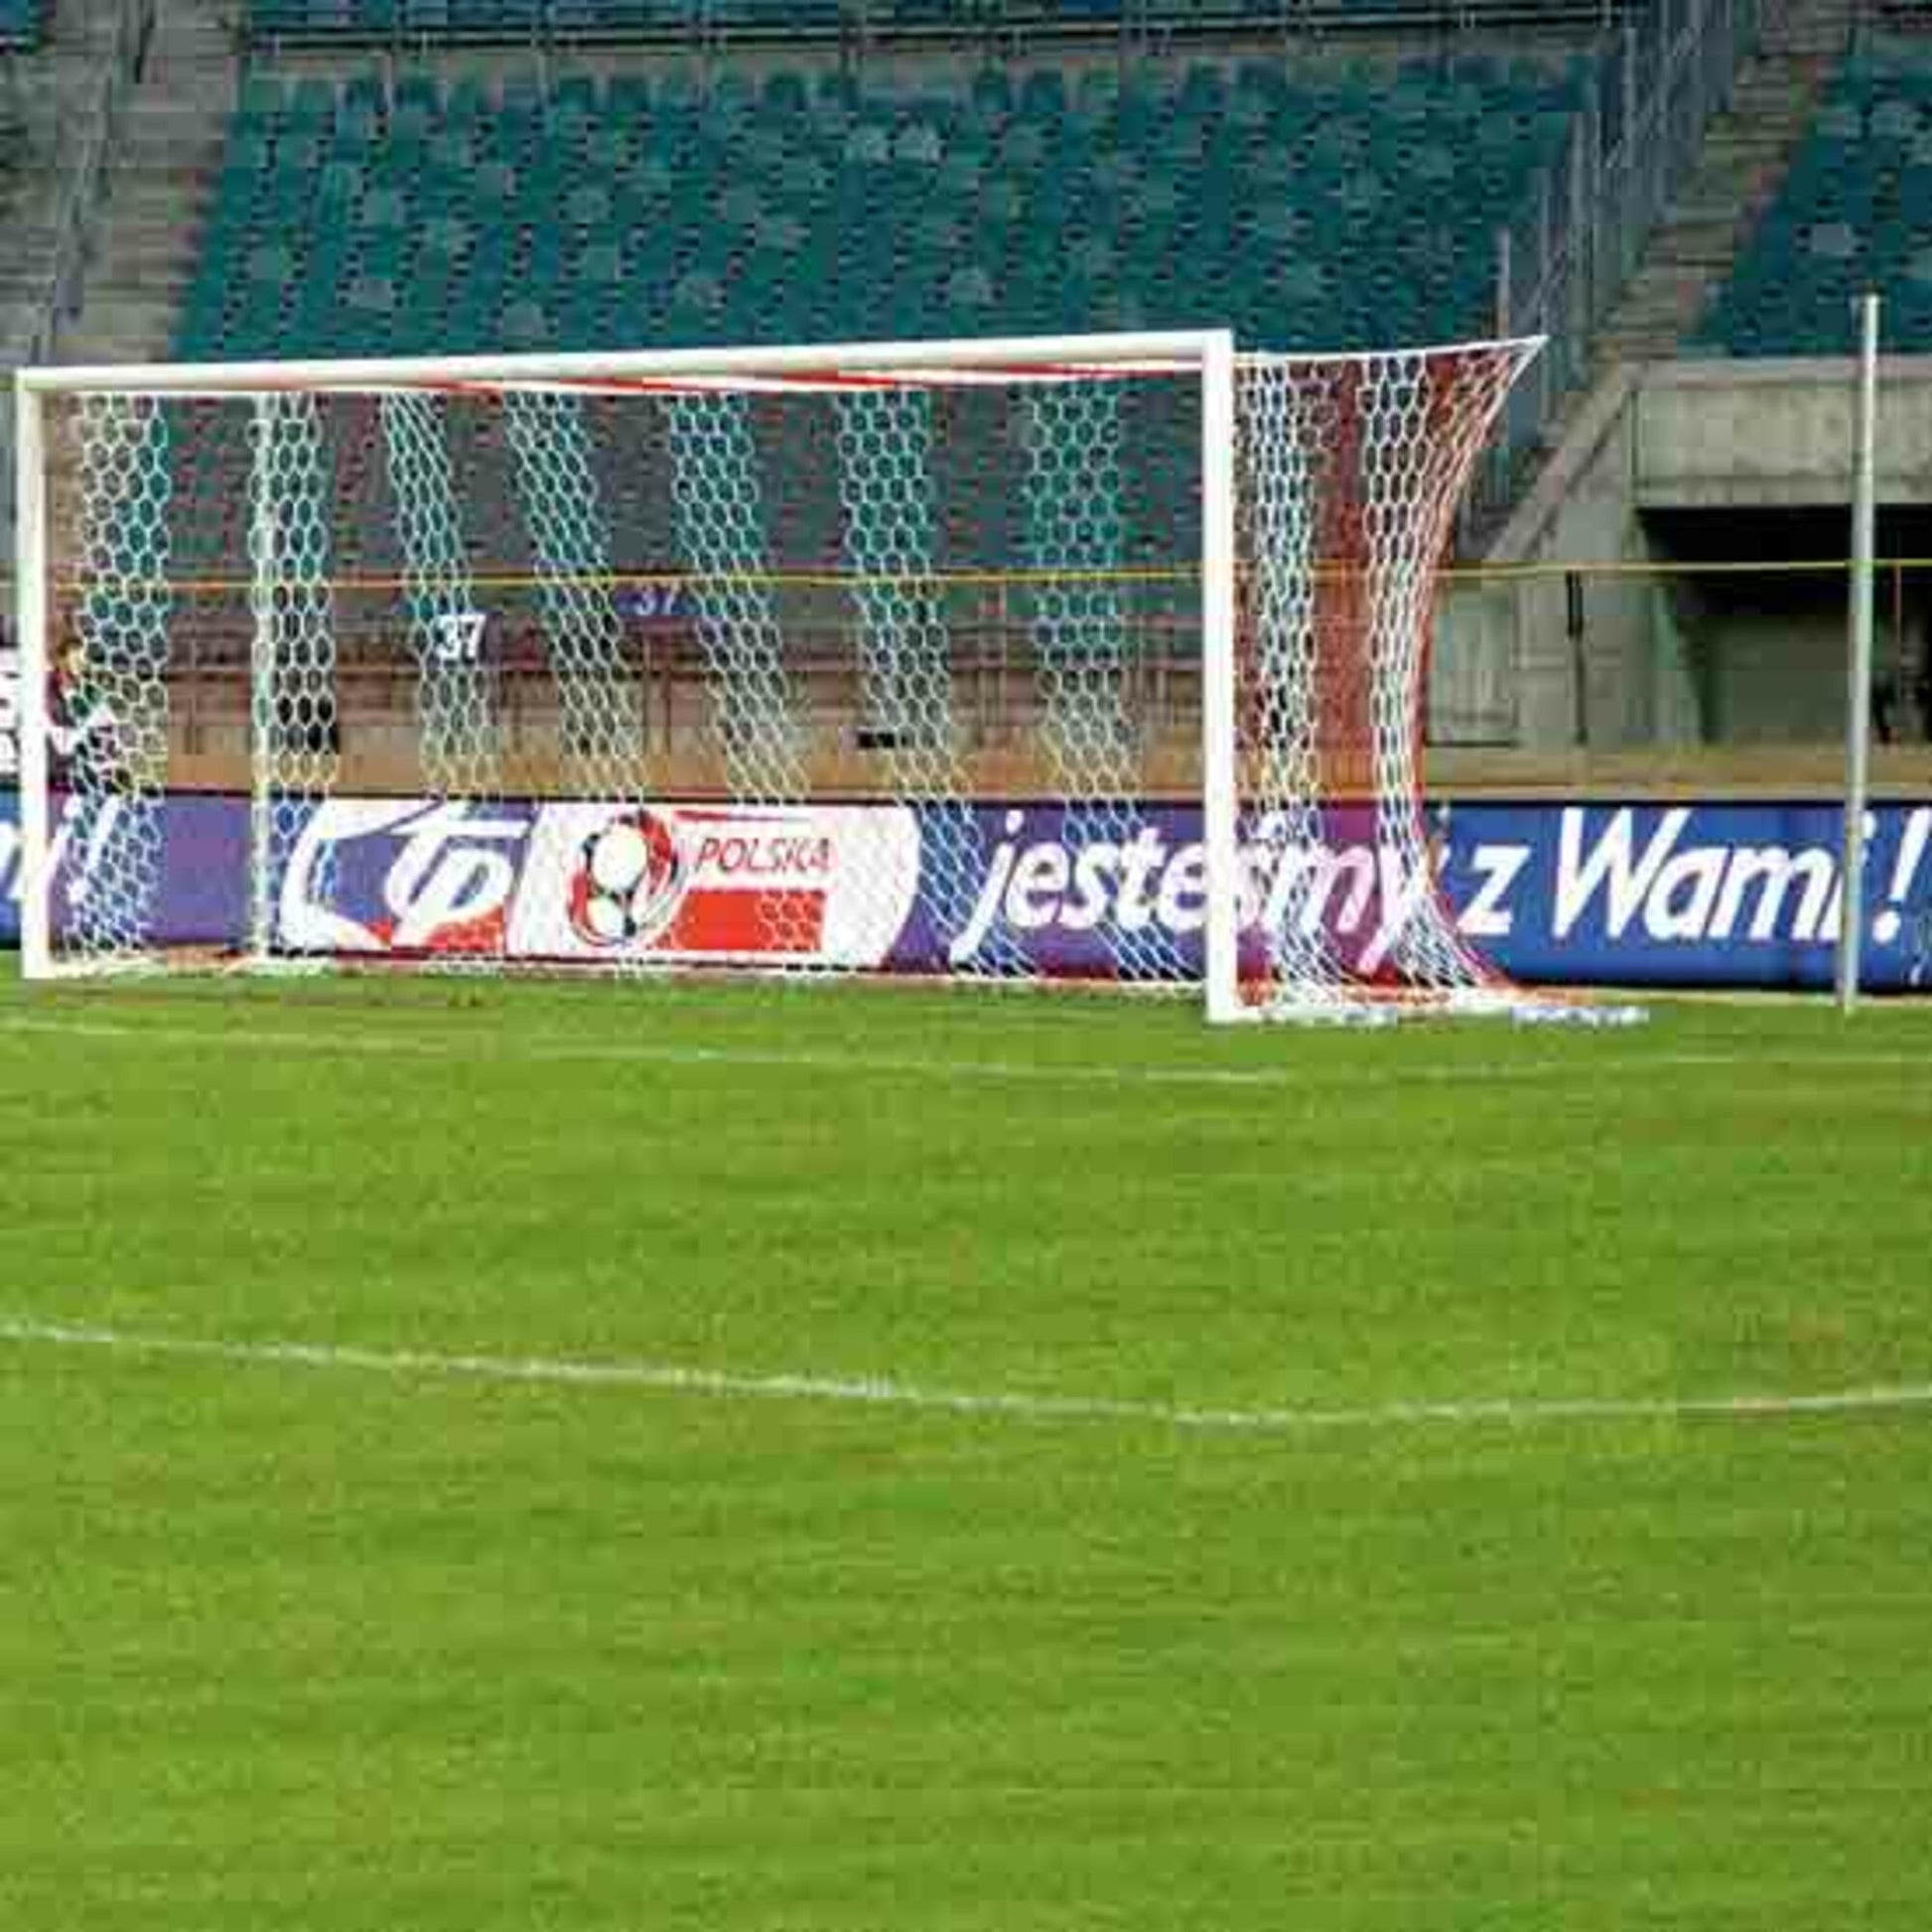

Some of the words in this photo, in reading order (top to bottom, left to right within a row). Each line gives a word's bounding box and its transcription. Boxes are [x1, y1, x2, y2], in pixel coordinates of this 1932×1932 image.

[437, 614, 485, 658] 37
[696, 837, 830, 872] POLSKA
[1456, 844, 1530, 933] z
